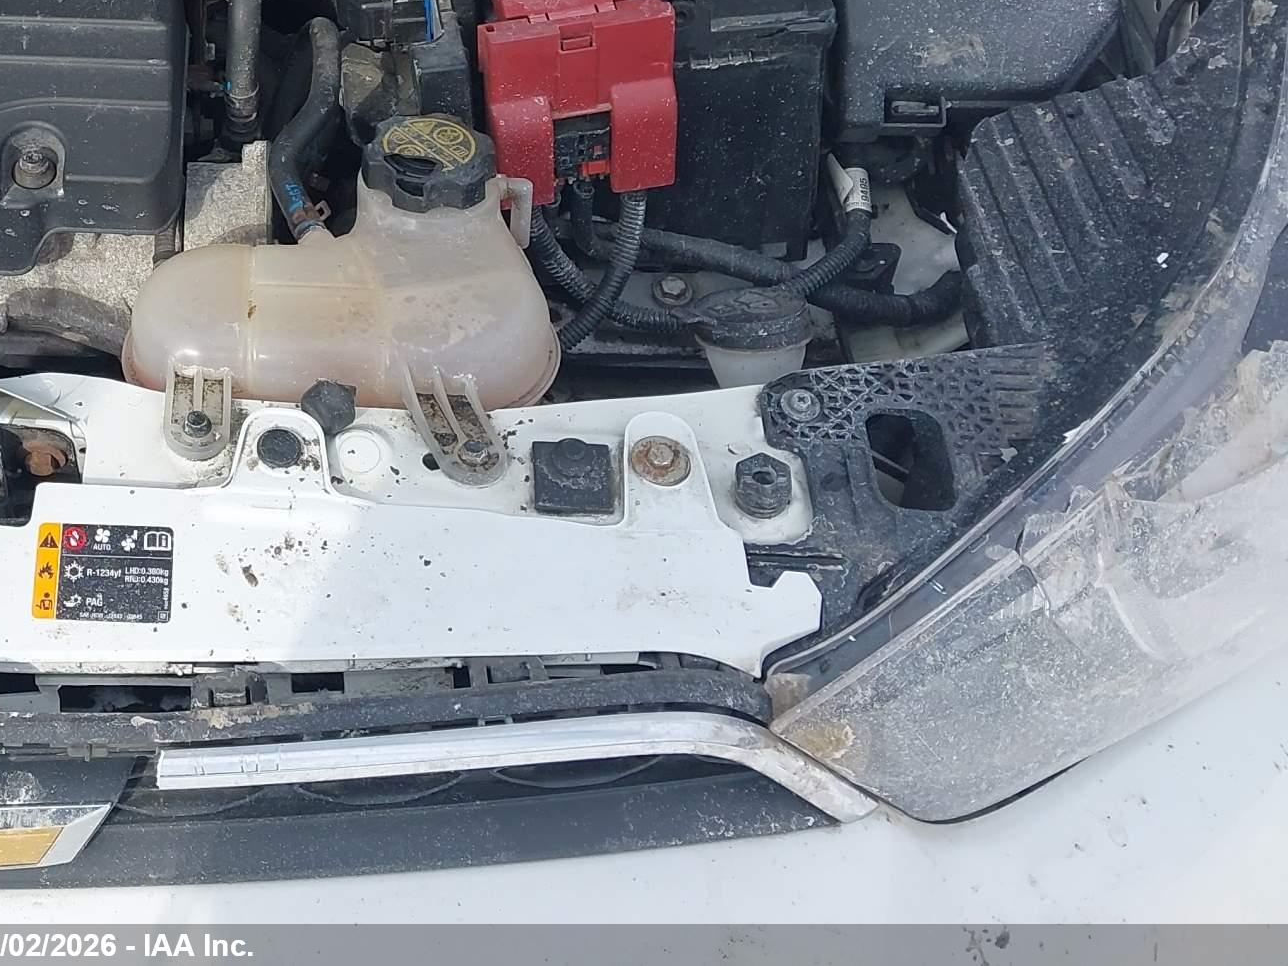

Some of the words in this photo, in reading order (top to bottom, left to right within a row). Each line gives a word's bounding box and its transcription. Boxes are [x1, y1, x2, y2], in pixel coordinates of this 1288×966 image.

[93, 543, 111, 551] AUTO
[86, 568, 122, 579] R-1234yf
[85, 597, 103, 607] PAG
